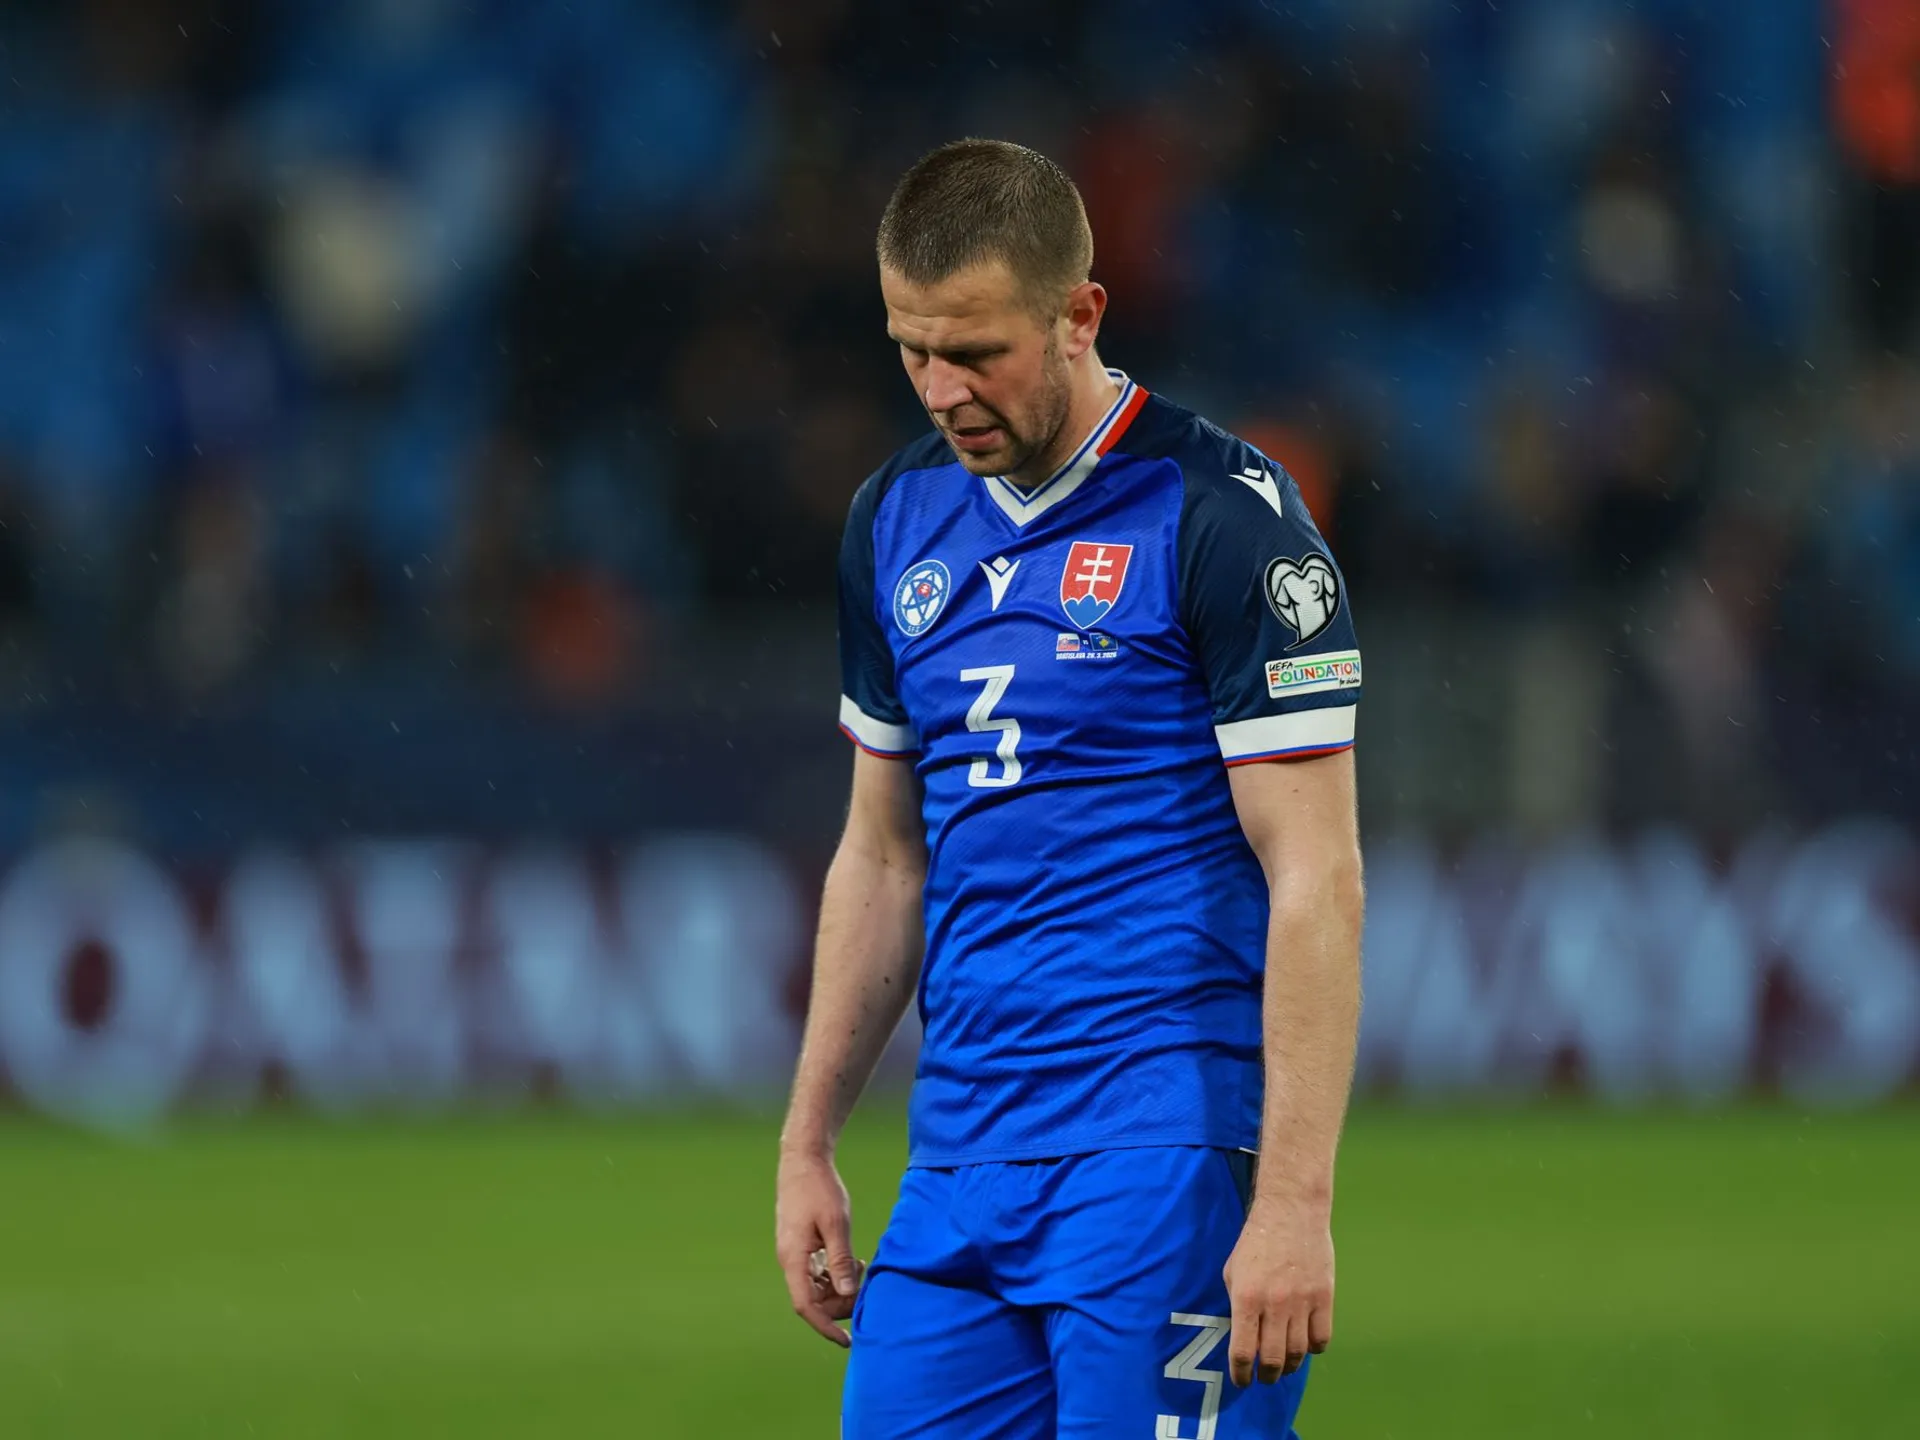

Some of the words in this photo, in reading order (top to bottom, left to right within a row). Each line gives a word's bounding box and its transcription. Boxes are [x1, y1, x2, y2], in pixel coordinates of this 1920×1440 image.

[1269, 661, 1294, 672] UEFA
[1269, 661, 1360, 685] FOUNDATION
[960, 664, 1022, 788] 3
[1155, 1311, 1231, 1440] 3
